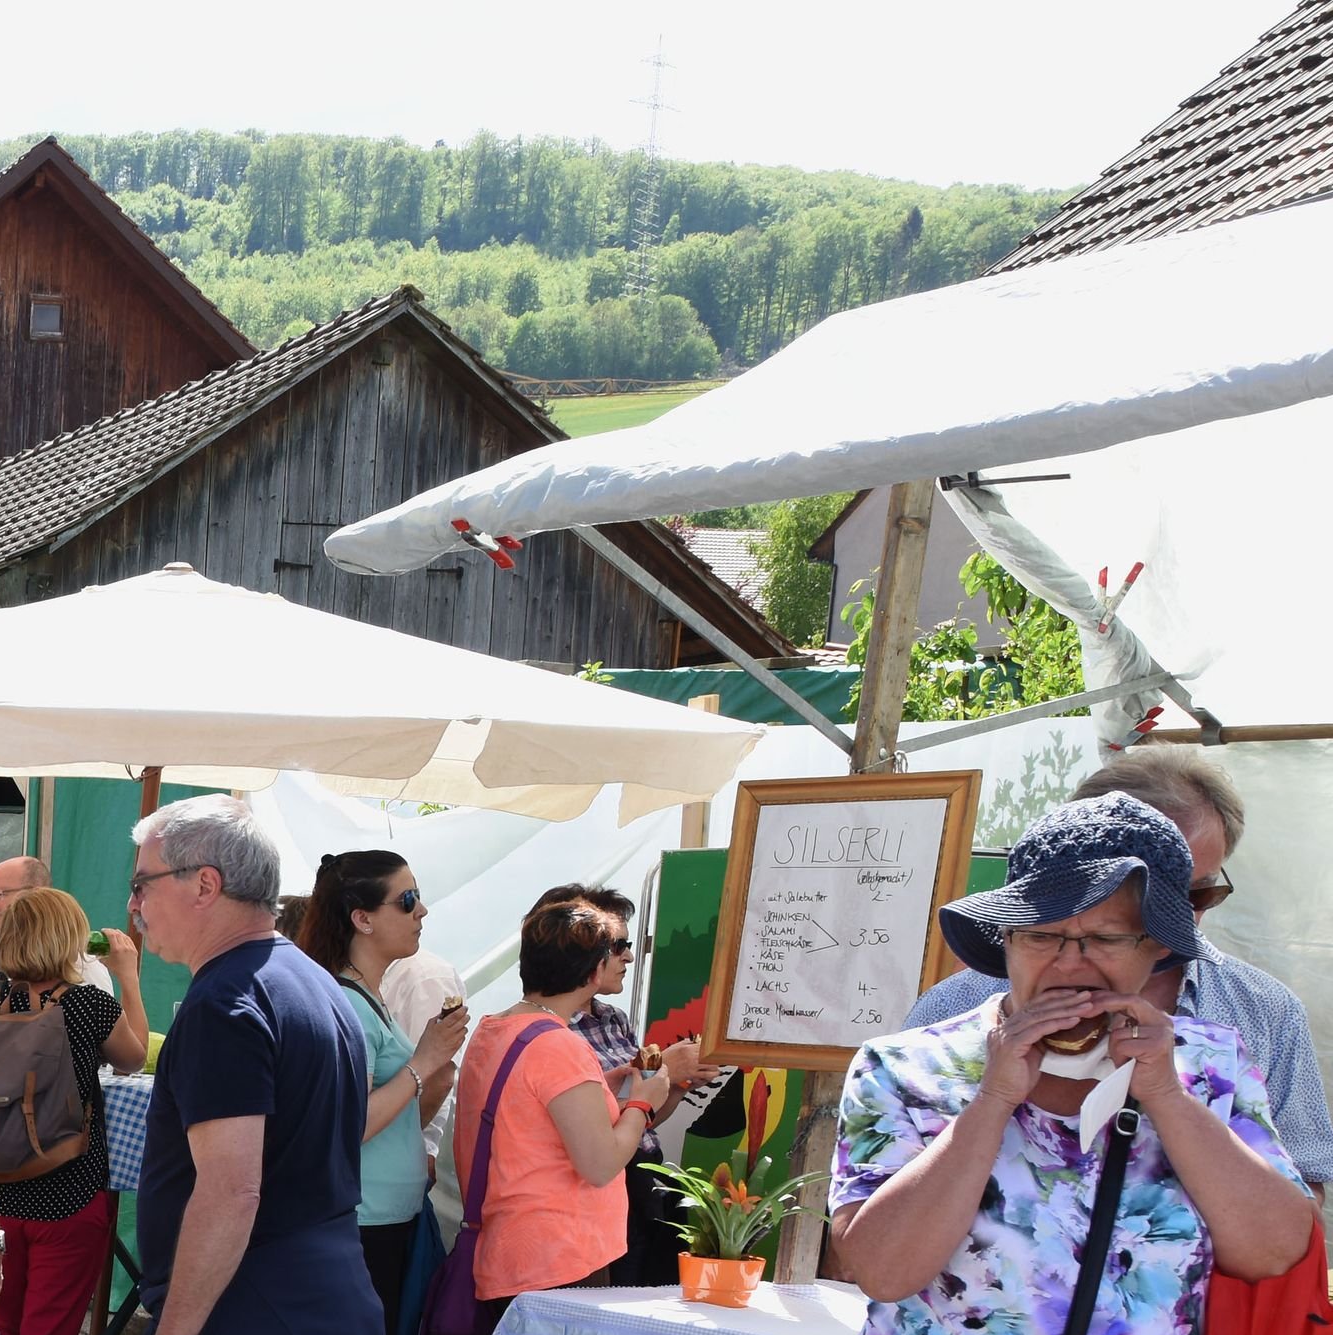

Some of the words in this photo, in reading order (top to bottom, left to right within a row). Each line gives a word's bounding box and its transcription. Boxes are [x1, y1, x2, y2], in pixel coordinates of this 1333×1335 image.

[764, 910, 811, 923] SCHINKEN
[761, 923, 796, 937] SALAMI
[760, 936, 813, 952] FLEISCHKÄSE
[849, 928, 890, 947] 3.50
[760, 948, 785, 961] KÄSE
[756, 962, 783, 972] THON
[755, 981, 790, 992] LACHS
[851, 1008, 882, 1024] 2.50
